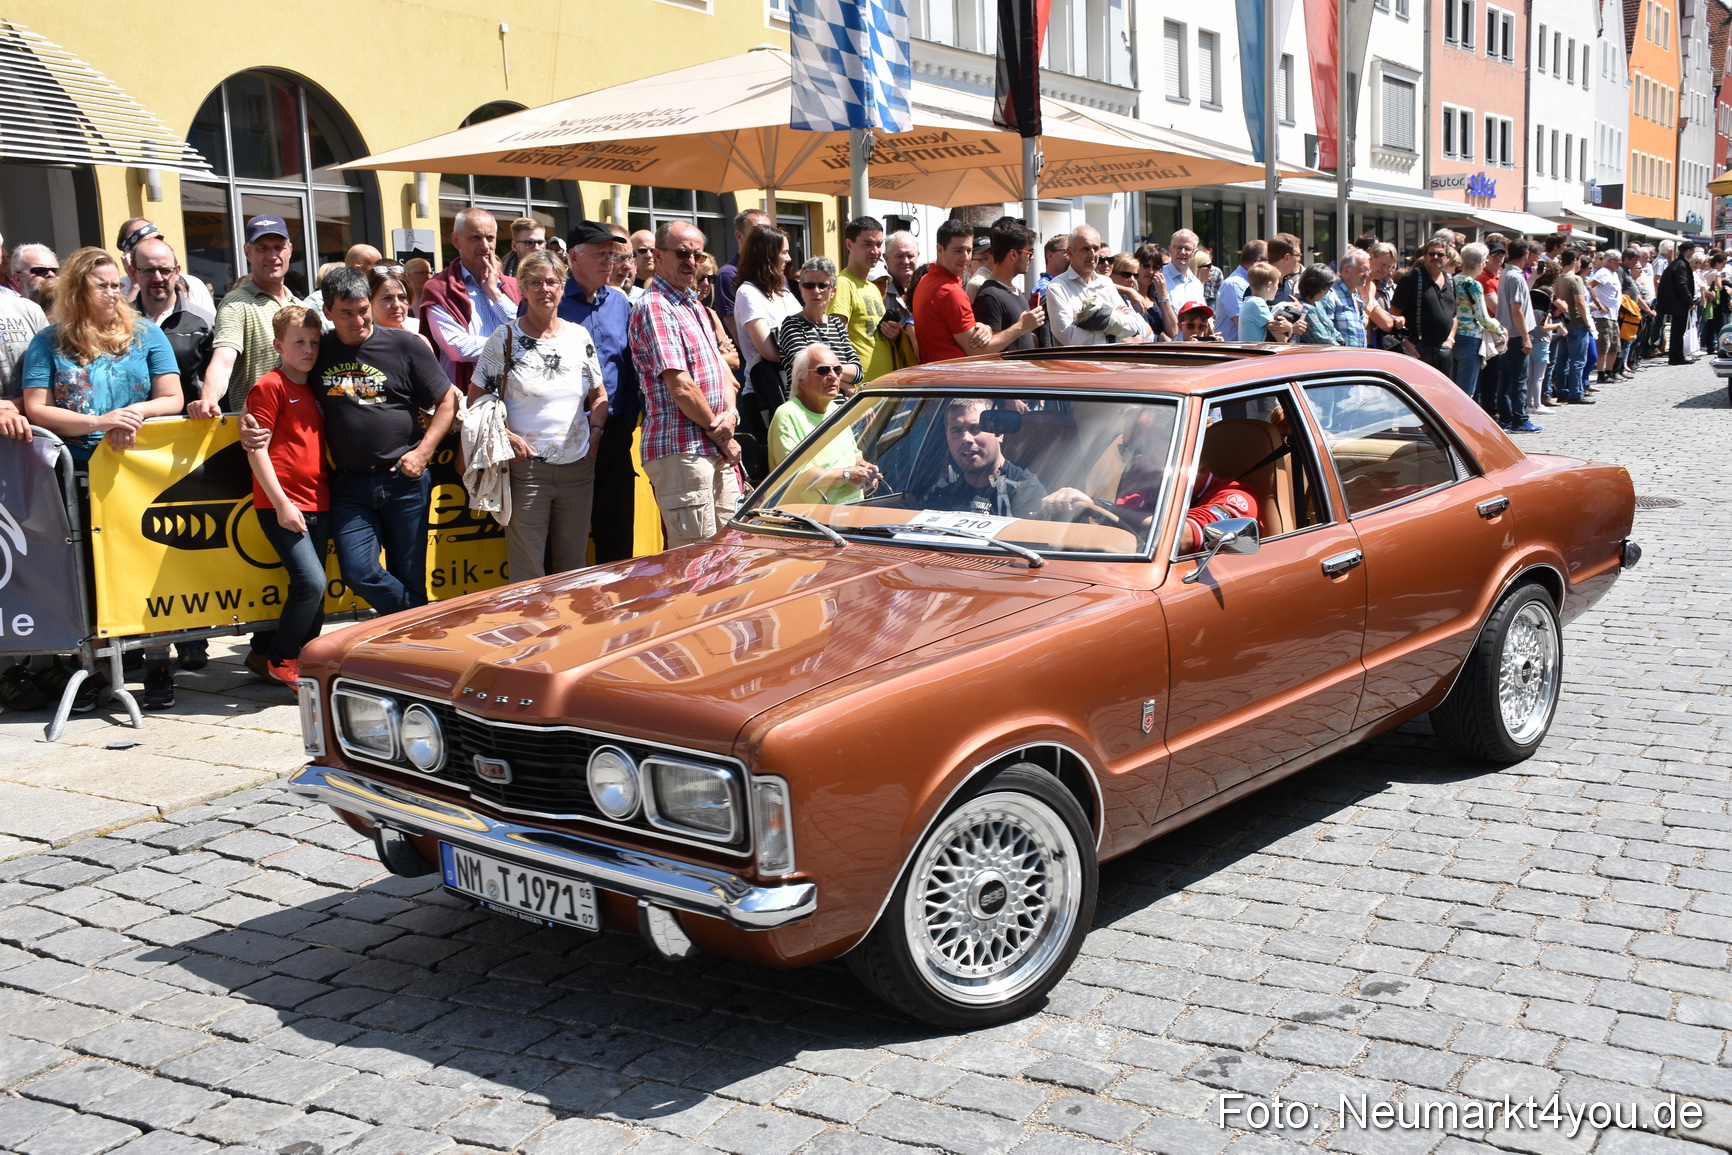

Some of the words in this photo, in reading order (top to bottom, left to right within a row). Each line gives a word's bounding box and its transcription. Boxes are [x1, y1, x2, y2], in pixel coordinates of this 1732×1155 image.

[549, 106, 697, 129] Neumarkter
[496, 114, 700, 143] Lammsbräu
[1431, 177, 1465, 188] sutor.
[826, 219, 837, 233] 24
[2, 331, 28, 343] CITY
[321, 362, 358, 380] AMAZON
[361, 363, 387, 381] RIVER
[952, 518, 993, 529] 210
[462, 686, 534, 706] FORD
[447, 870, 454, 881] D
[455, 852, 484, 894] NM
[517, 873, 579, 921] 1971
[579, 888, 592, 899] 05
[582, 913, 594, 925] 07
